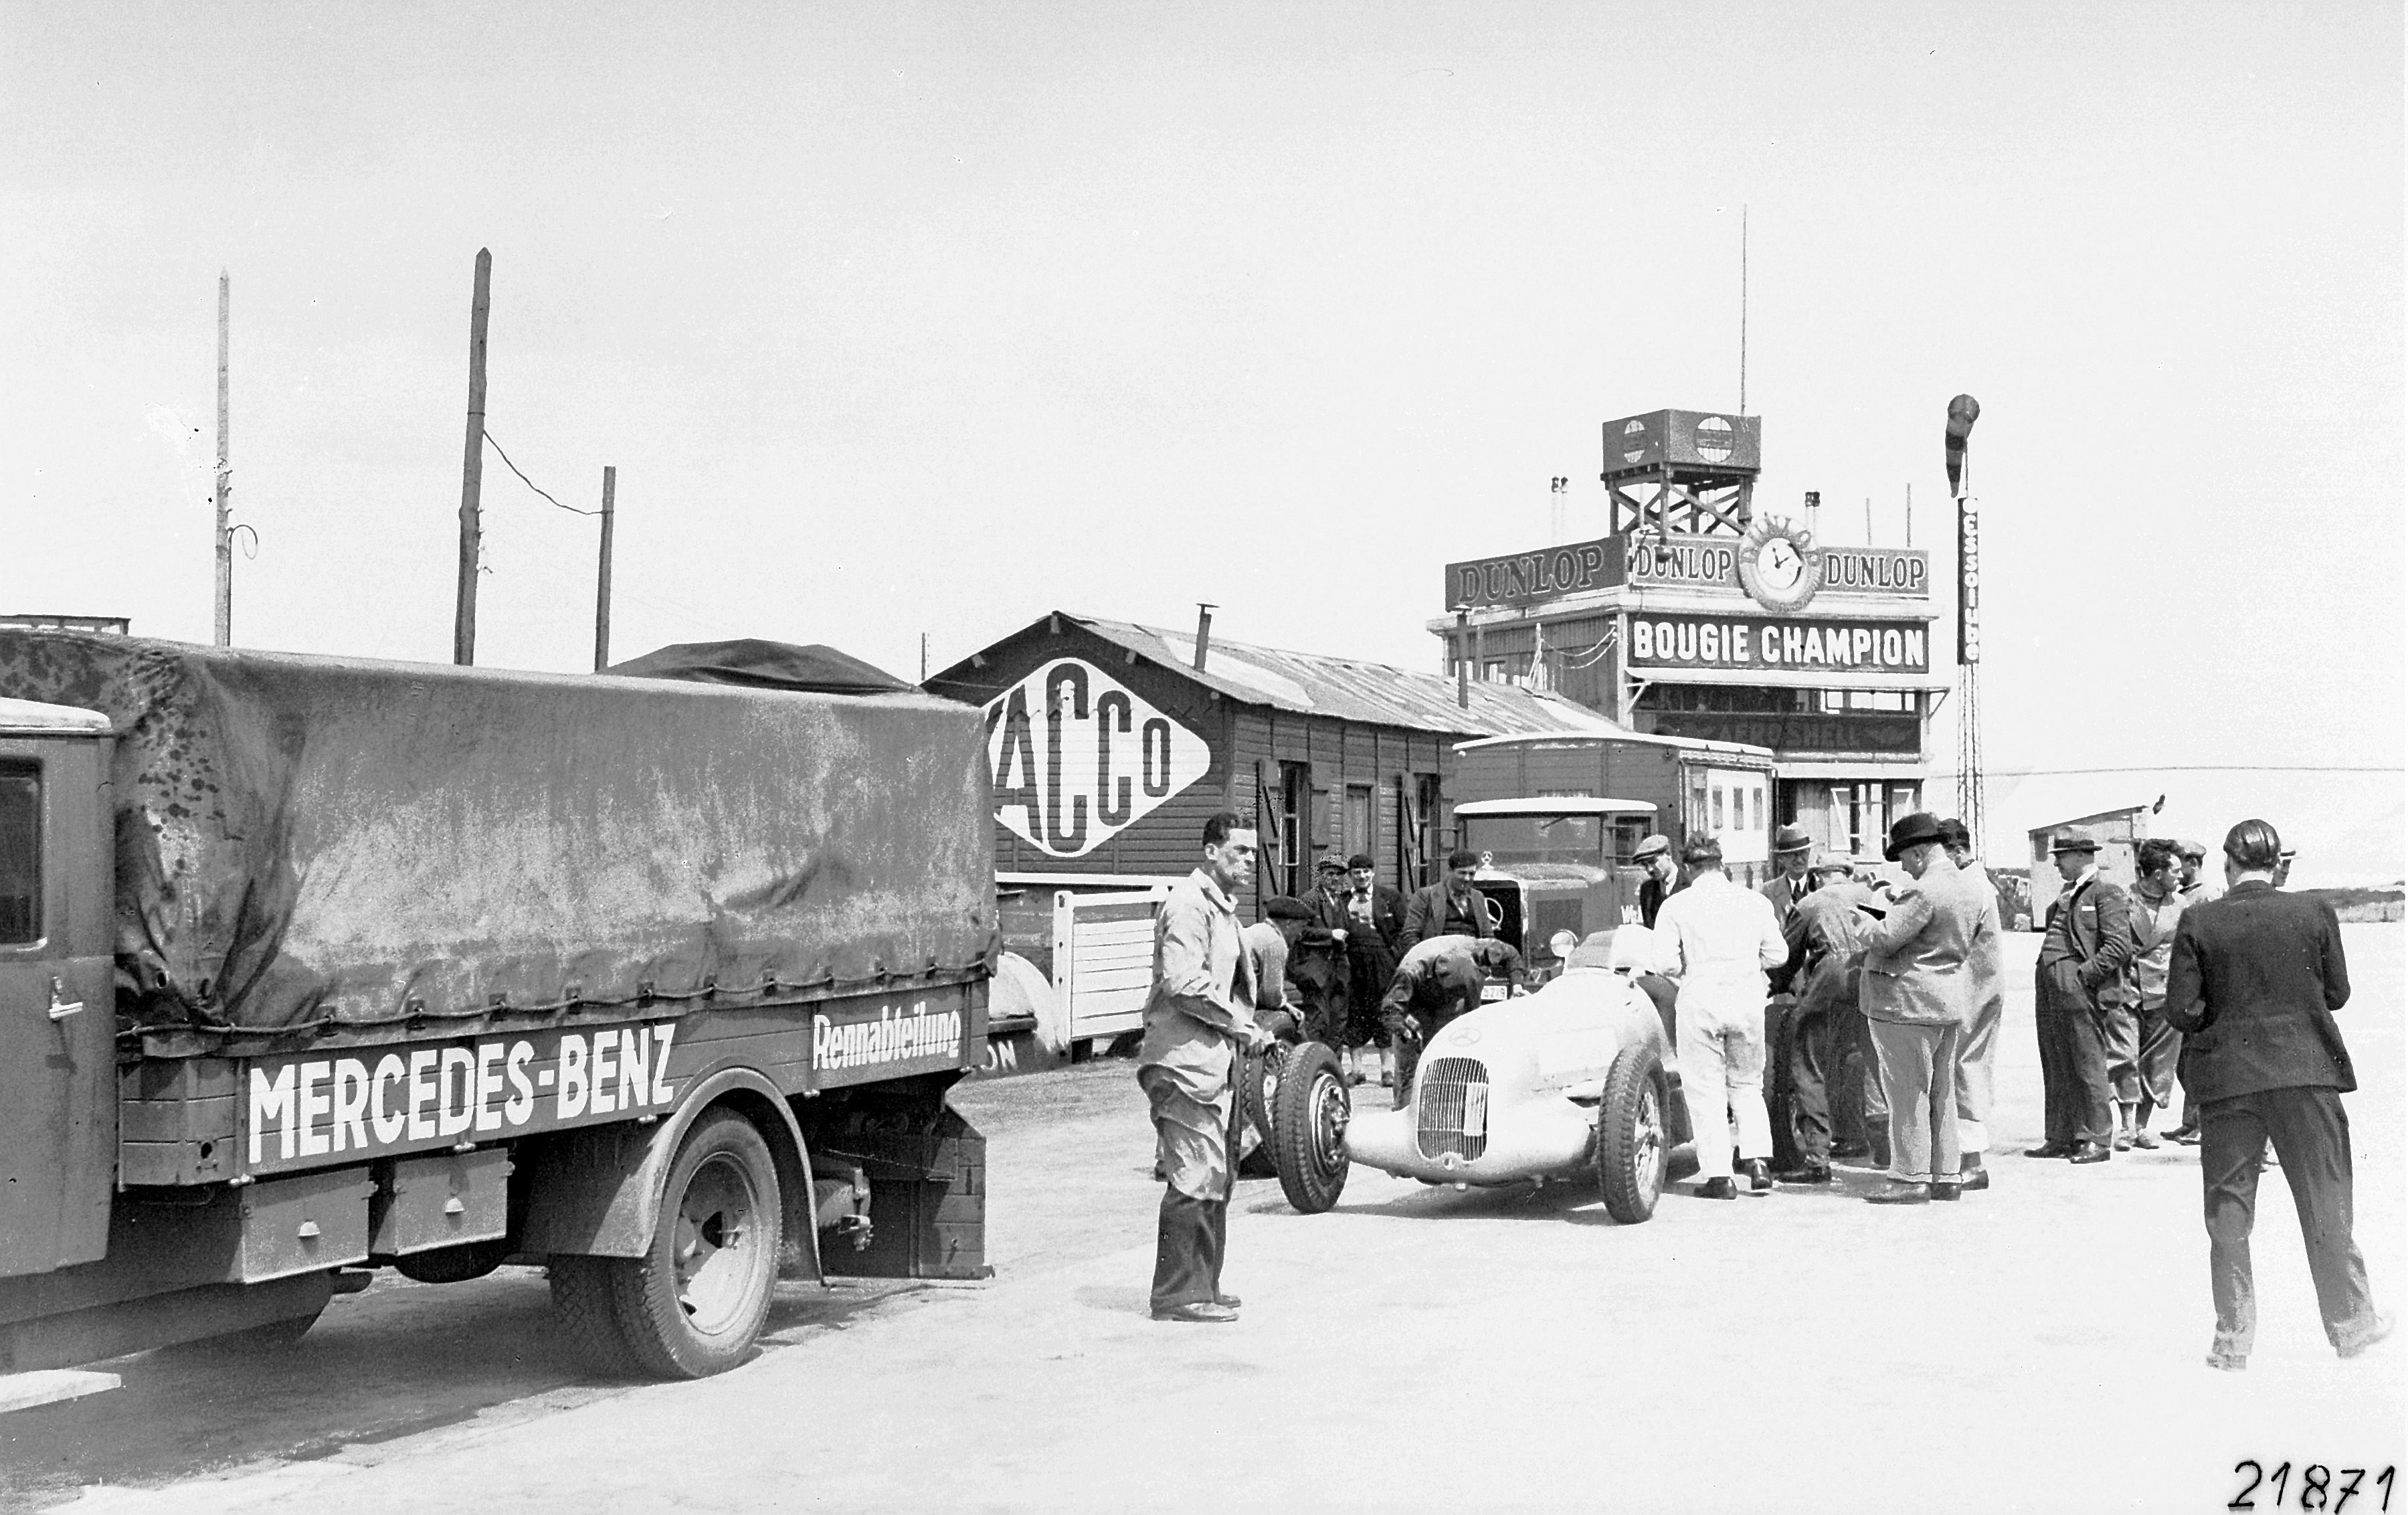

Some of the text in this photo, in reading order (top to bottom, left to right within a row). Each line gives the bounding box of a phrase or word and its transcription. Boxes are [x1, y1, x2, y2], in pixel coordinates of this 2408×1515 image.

[1457, 544, 1604, 603] DUNLOP
[1637, 545, 1733, 582] DUNLOP
[1825, 553, 1925, 588] DUNLOP
[1633, 621, 1924, 666] BOUGIE CHAMPION
[985, 661, 1171, 853] ACCO
[812, 1000, 961, 1071] Rennabteilung
[249, 1023, 676, 1164] MERCEDES-BENZ
